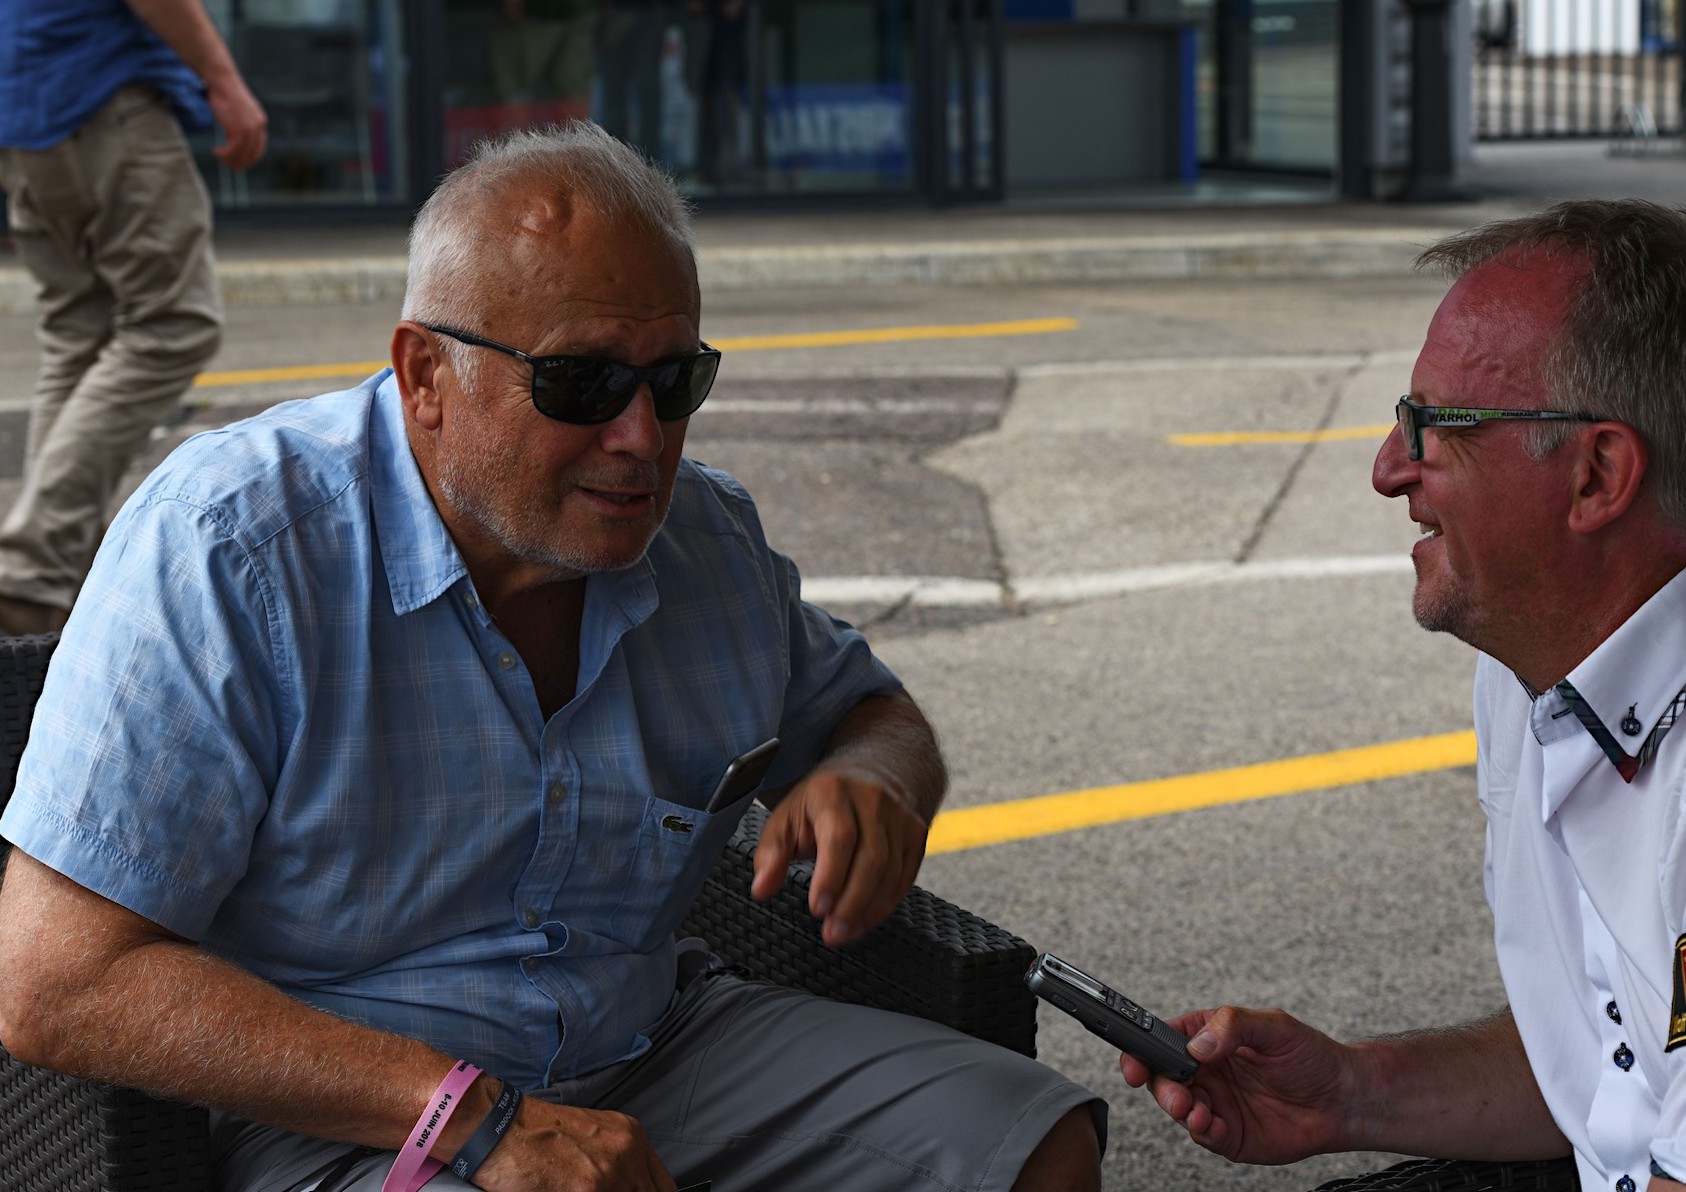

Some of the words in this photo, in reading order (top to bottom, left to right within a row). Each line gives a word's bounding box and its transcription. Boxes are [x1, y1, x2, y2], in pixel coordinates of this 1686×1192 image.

[1429, 413, 1479, 422] WARHOL
[439, 1093, 452, 1110] 8-10
[498, 1092, 509, 1110] TEAM
[427, 1109, 442, 1130] JUIN
[416, 1128, 431, 1148] 2018
